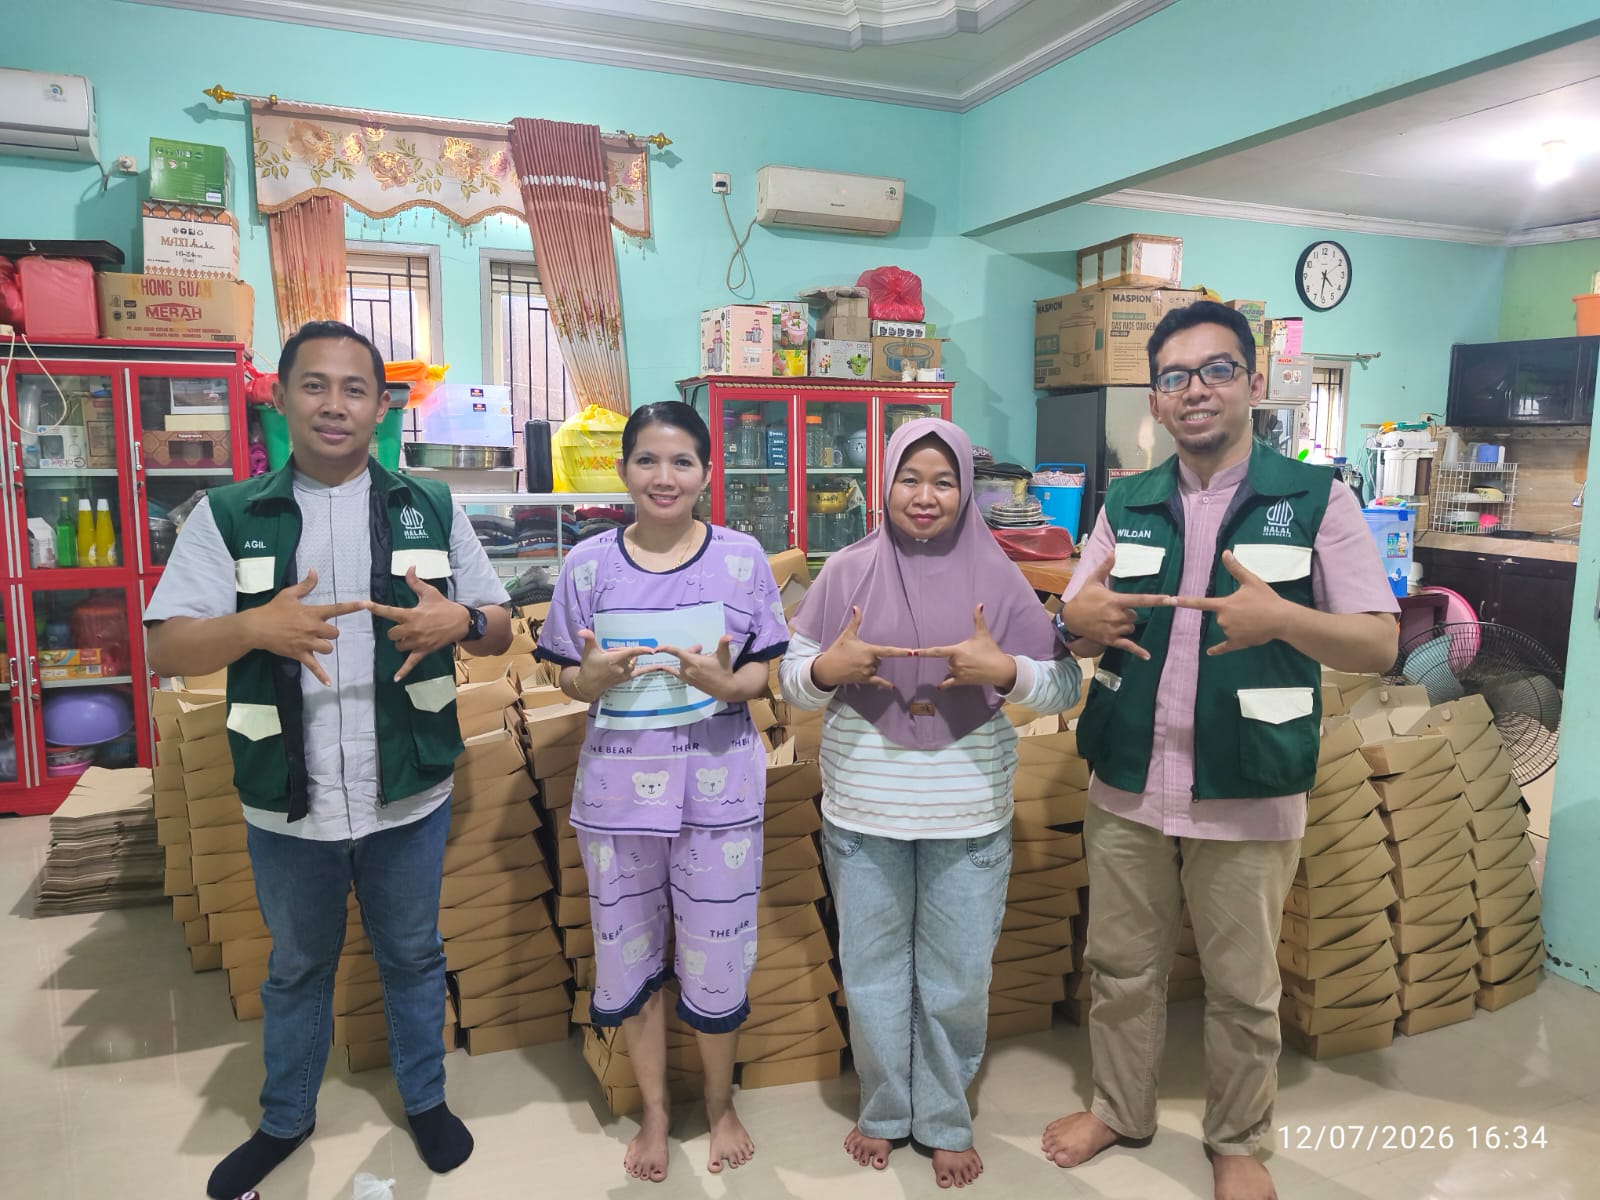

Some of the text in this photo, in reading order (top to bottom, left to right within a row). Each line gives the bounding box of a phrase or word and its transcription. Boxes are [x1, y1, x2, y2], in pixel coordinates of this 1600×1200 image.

[160, 236, 189, 247] MAXI
[1313, 251, 1318, 259] 11
[1322, 247, 1328, 255] 12
[1332, 250, 1335, 258] 1
[1306, 260, 1312, 268] 10
[1341, 271, 1344, 279] 3
[178, 279, 213, 298] GUAN
[1306, 285, 1310, 293] 8
[1112, 294, 1152, 303] MASPION
[1313, 293, 1317, 301] 7
[1321, 296, 1326, 304] 6
[1330, 292, 1334, 300] 5
[1036, 301, 1063, 314] MASPION
[146, 306, 202, 319] MERAH
[1263, 525, 1290, 533] HALAL
[1116, 529, 1151, 538] WILDAN
[244, 540, 267, 549] AGIL
[606, 746, 633, 755] BEAR
[709, 929, 730, 938] THE
